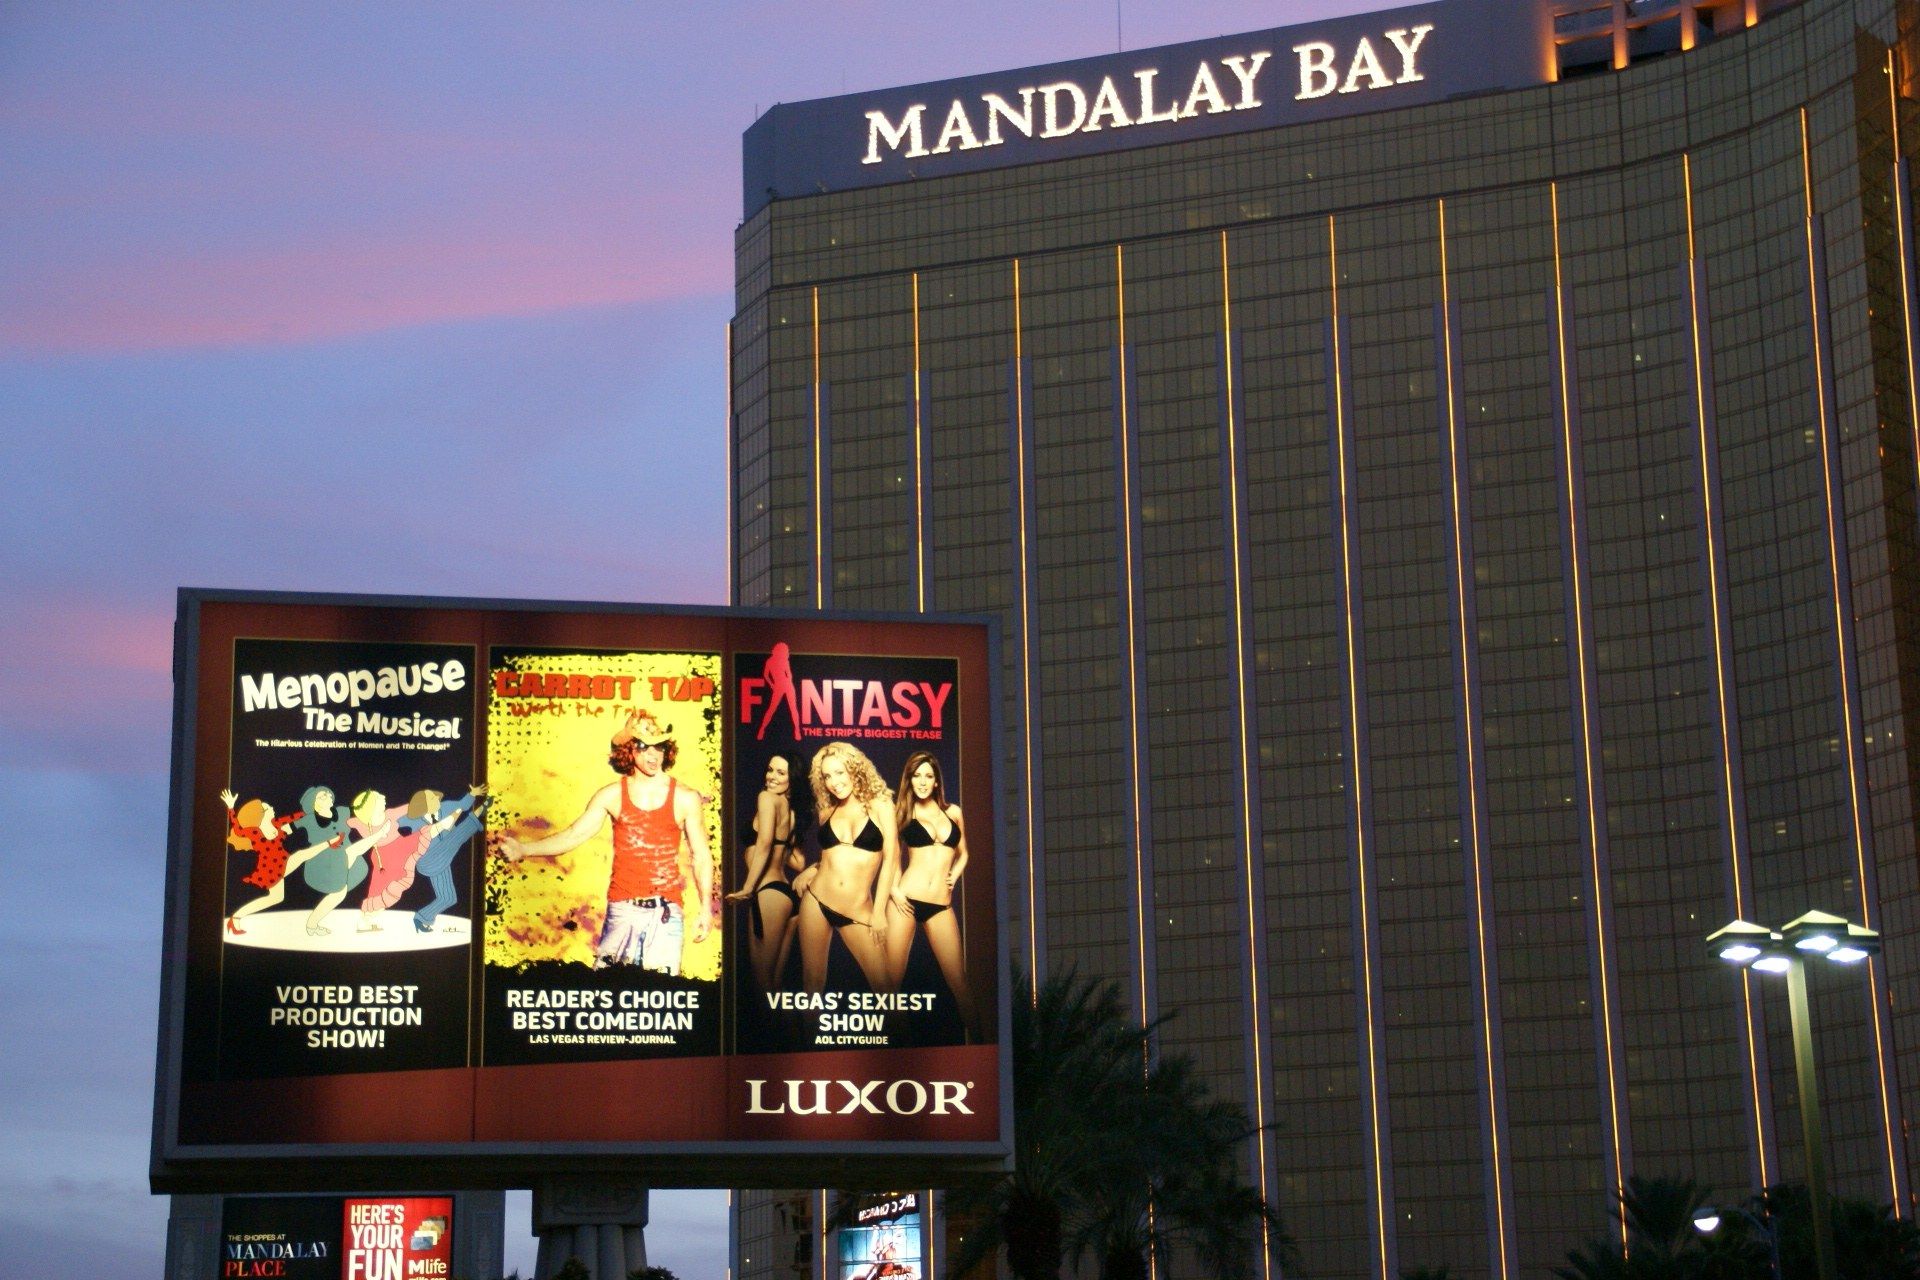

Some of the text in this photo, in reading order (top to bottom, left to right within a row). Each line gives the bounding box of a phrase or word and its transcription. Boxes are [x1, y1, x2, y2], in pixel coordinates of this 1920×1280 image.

[862, 25, 1433, 164] MANDALAY BAY
[241, 659, 466, 712] Menopause
[495, 671, 714, 701] CARROT TOP
[740, 642, 952, 740] FANTASY
[303, 707, 461, 739] The Musical
[803, 728, 942, 740] THE STRIP'S BIGGEST TEASE
[255, 739, 269, 747] The
[304, 740, 347, 749] Celebration
[348, 741, 356, 749] of
[386, 742, 400, 750] and
[402, 742, 415, 750] The
[276, 985, 418, 1004] VOTED BEST
[507, 989, 699, 1009] READER'S CHOICE
[767, 992, 936, 1011] VEGAS' SEXIEST
[271, 1007, 422, 1026] PRODUCTION
[513, 1011, 693, 1030] BEST COMEDIAN
[819, 1013, 884, 1032] SHOW
[307, 1029, 385, 1048] SHOW!
[530, 1034, 676, 1044] LAS VEGAS REVIEW-JOURNAL
[815, 1035, 888, 1045] AOL CITYGUIDE
[745, 1079, 975, 1115] LUXOR
[351, 1204, 404, 1224] HERE'S
[277, 1233, 286, 1241] AT
[351, 1224, 404, 1249] YOUR
[227, 1241, 328, 1259] MANDALAY
[225, 1260, 286, 1277] PLACE
[348, 1249, 403, 1280] FUN
[408, 1258, 447, 1274] Mlife
